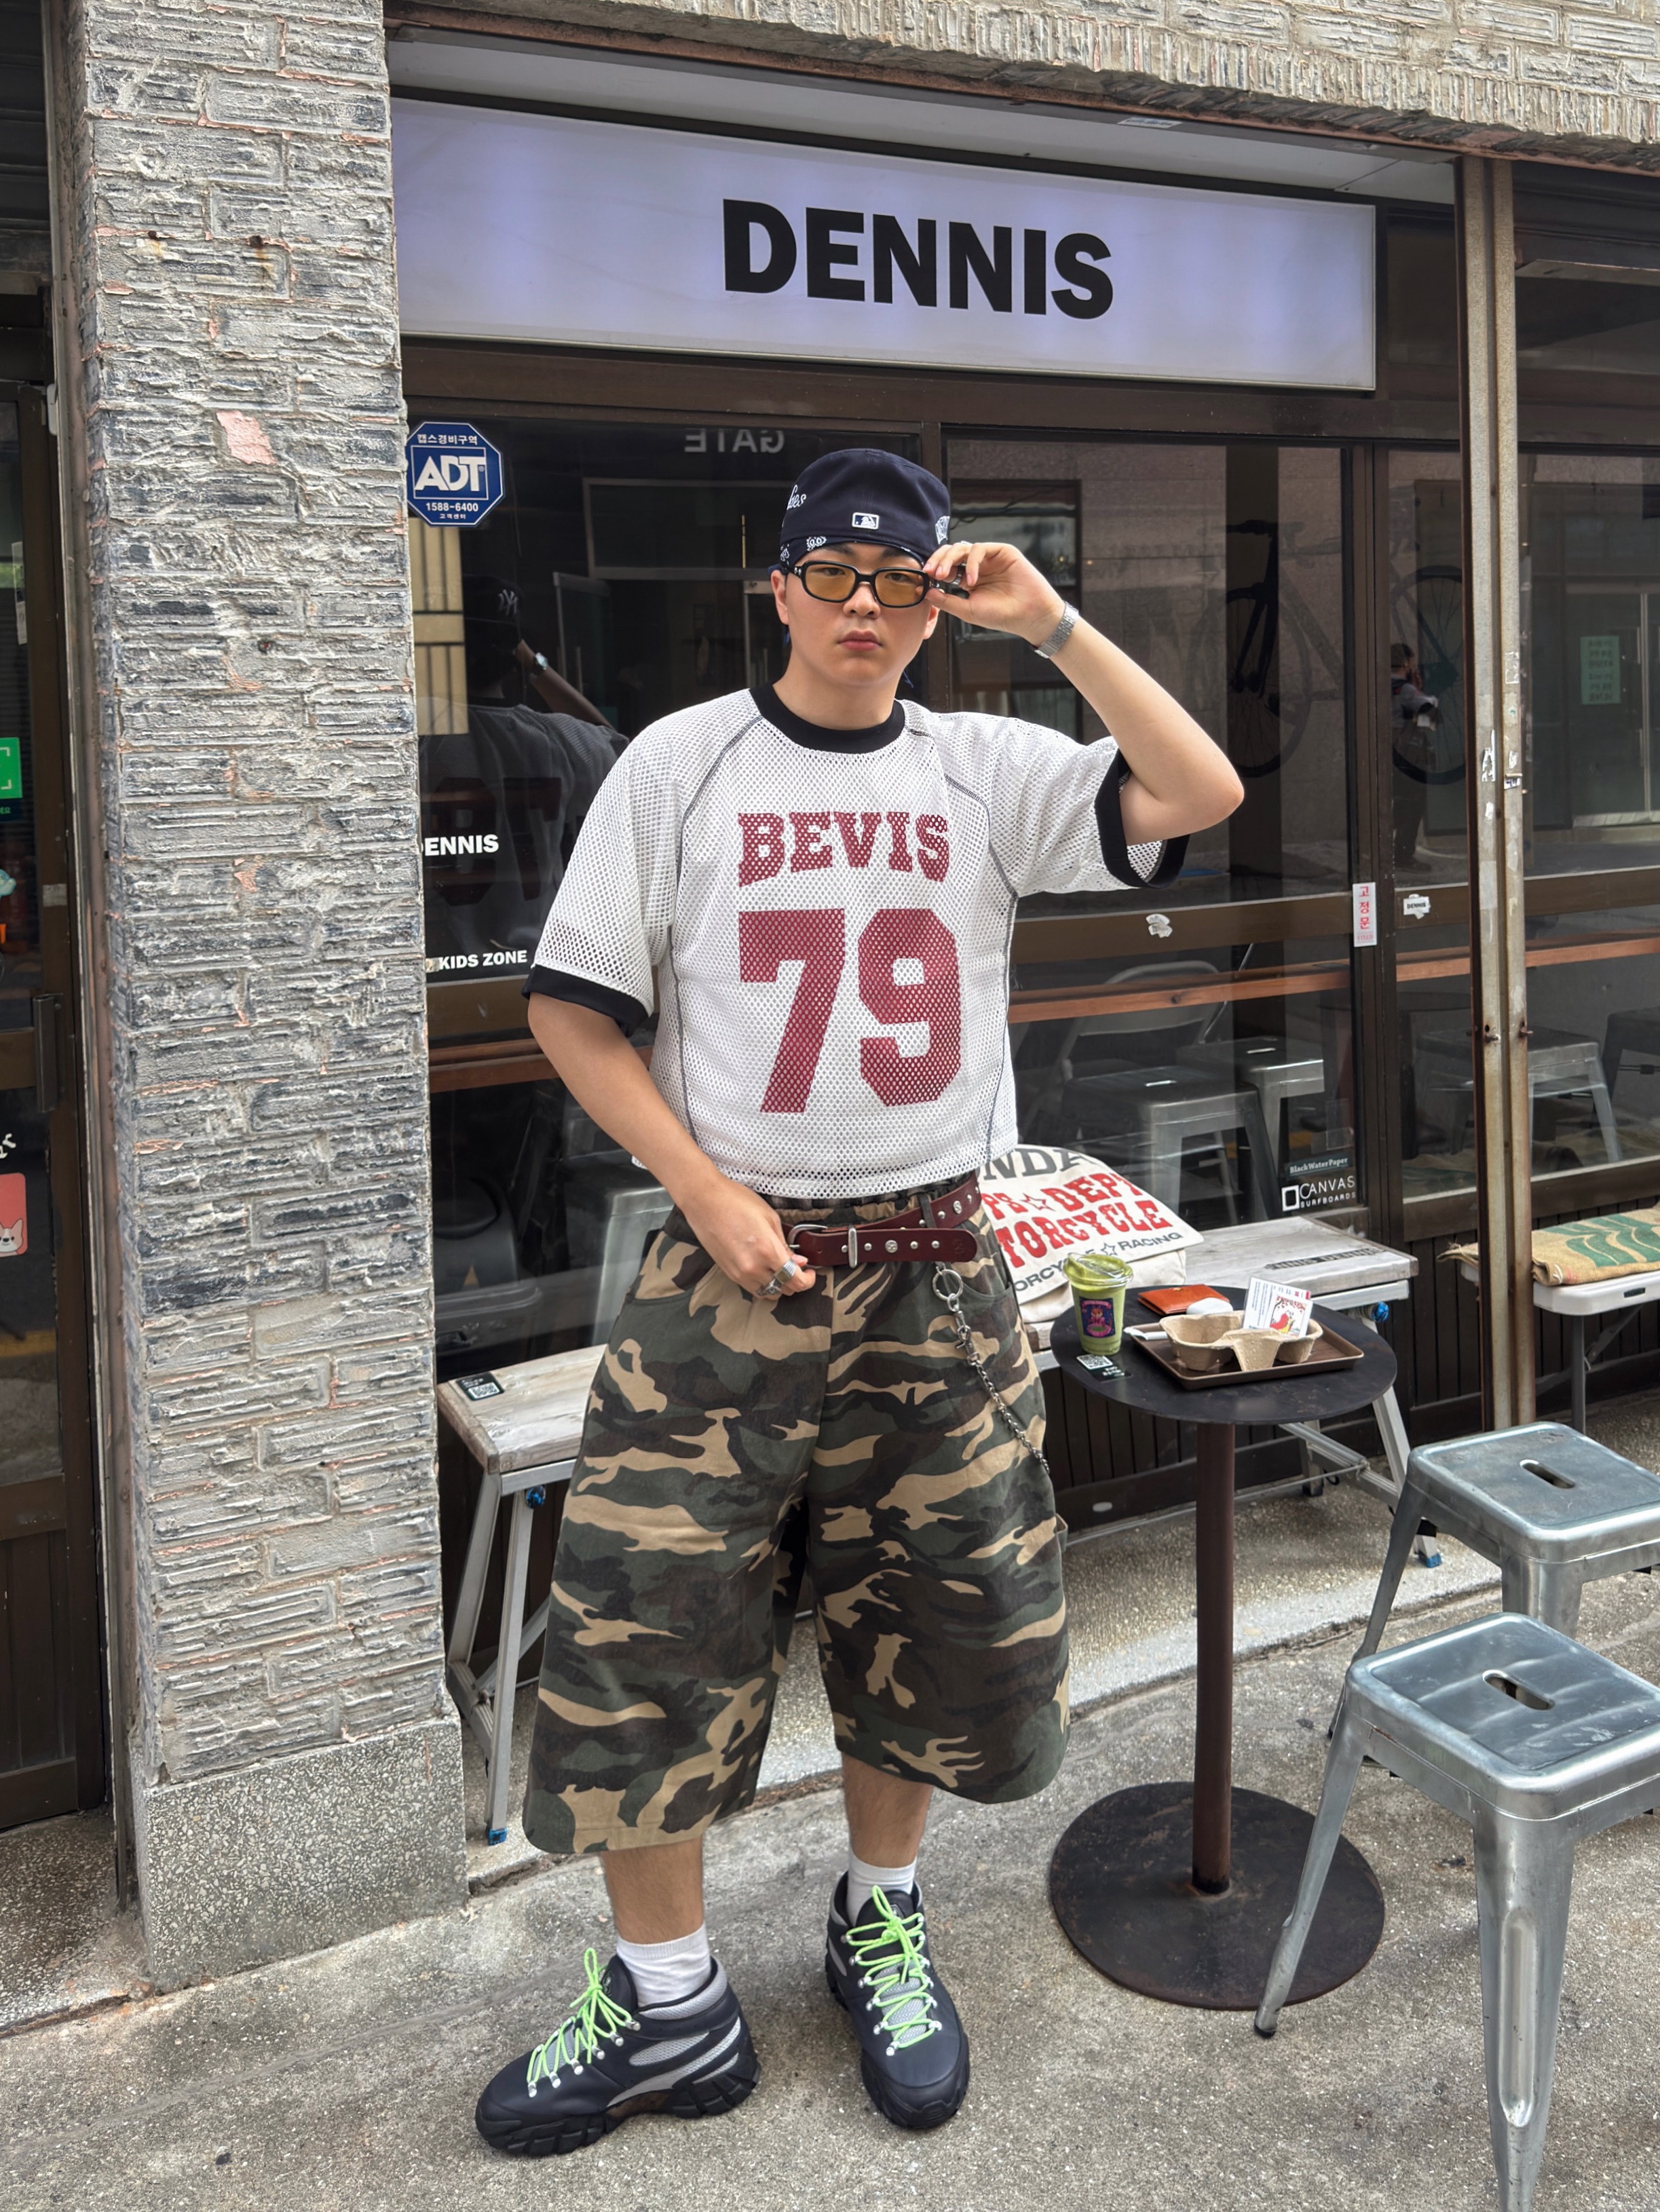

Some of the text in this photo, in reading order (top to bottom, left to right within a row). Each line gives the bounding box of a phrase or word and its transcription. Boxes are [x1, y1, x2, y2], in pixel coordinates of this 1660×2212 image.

[723, 199, 1113, 320] DENNIS
[417, 434, 478, 445] 캡스경비구역
[415, 455, 485, 491] ADT
[426, 502, 478, 512] 1588-6400
[421, 834, 499, 856] ENNIS
[738, 811, 949, 888] BEVIS
[1359, 886, 1370, 930] 고정문
[440, 950, 527, 970] KIDS ZONE
[738, 908, 961, 1113] 79
[1300, 1175, 1355, 1200] CANVAS
[1300, 1191, 1356, 1208] SURFBOARDS
[1117, 1232, 1183, 1251] RACING
